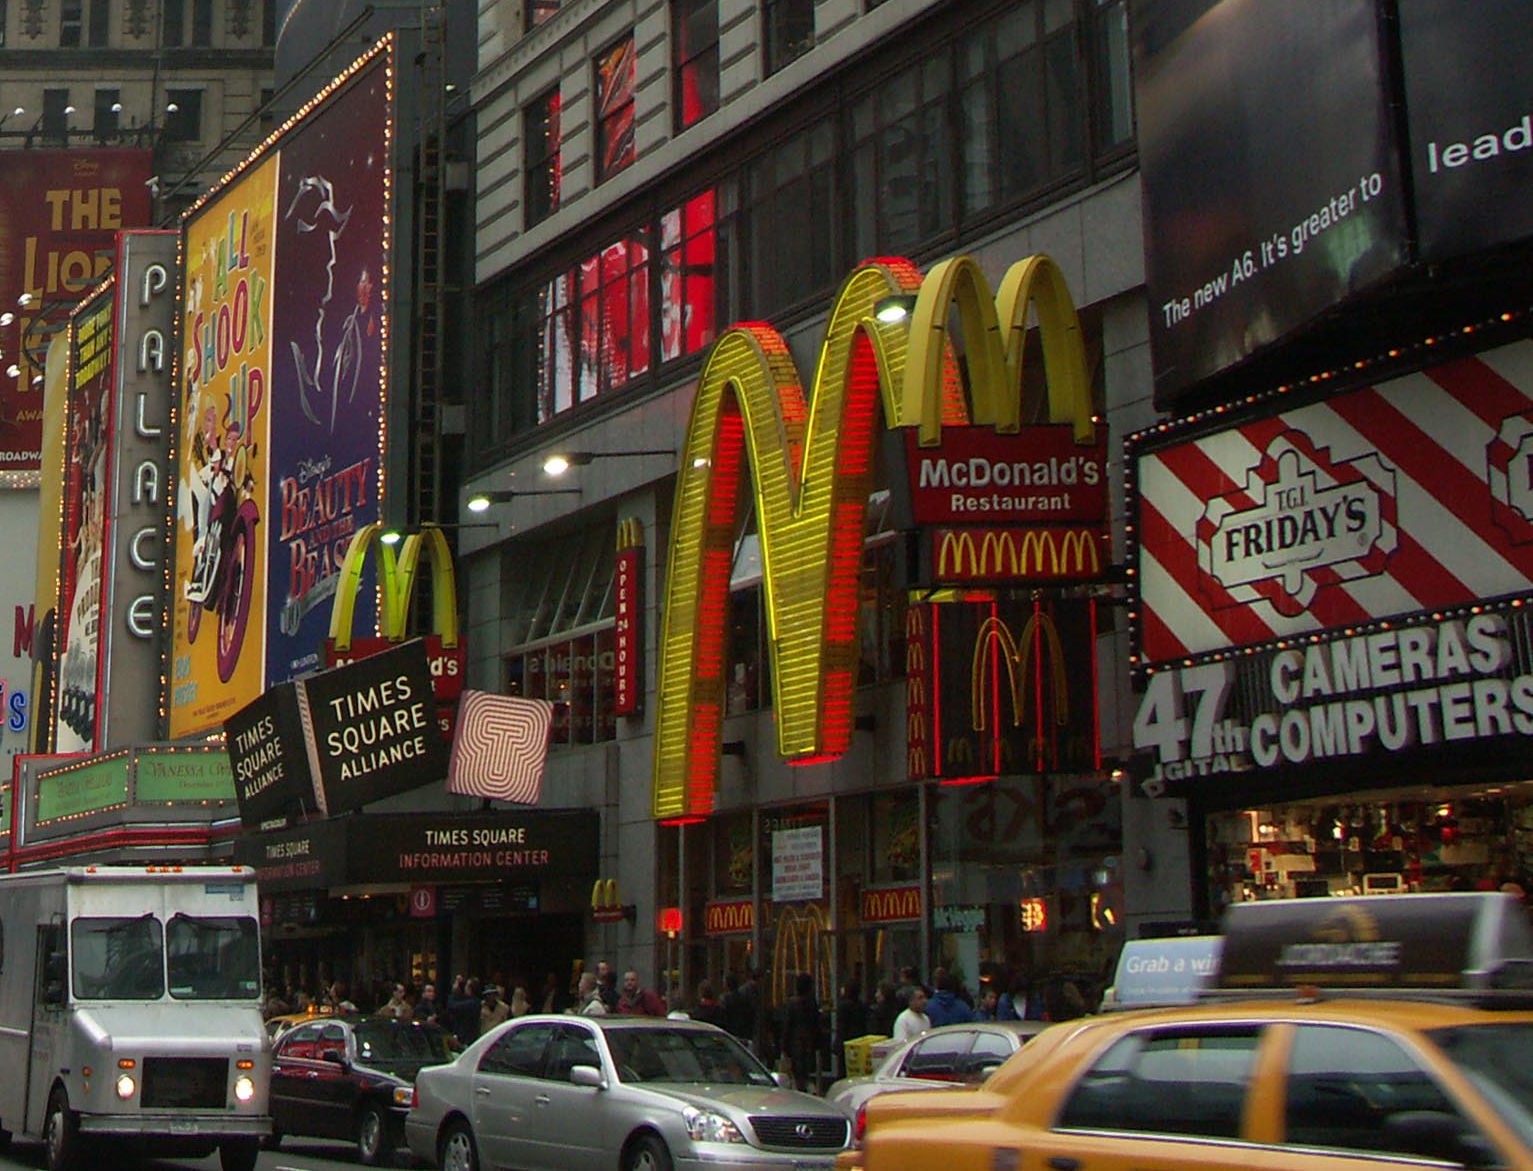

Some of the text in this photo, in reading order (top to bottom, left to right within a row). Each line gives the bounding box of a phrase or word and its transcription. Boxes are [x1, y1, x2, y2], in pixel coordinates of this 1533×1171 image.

[1427, 115, 1533, 173] lead
[43, 186, 124, 231] THE
[212, 208, 250, 303] ALL
[1161, 171, 1383, 329] The new A6. It's greater to
[192, 269, 266, 392] SHOOK
[126, 262, 169, 640] PALACE
[919, 454, 1101, 490] McDonald's
[279, 456, 372, 542] BEAUTY
[951, 491, 1071, 514] Restaurant
[1224, 493, 1367, 563] FRIDAY'S
[1271, 612, 1510, 706] CAMERAS
[329, 675, 412, 723] TIMES
[1131, 663, 1533, 768] 47th COMPUTERS
[235, 715, 274, 754] TIMES
[327, 702, 427, 758] SQUARE
[237, 736, 283, 782] SQUARE
[244, 762, 285, 800] ALLIANCE
[340, 736, 426, 781] ALLIANCE
[400, 850, 549, 869] INFORMATION CENTER
[426, 828, 526, 847] TIMES SQUARE
[1126, 954, 1186, 974] Grab a
